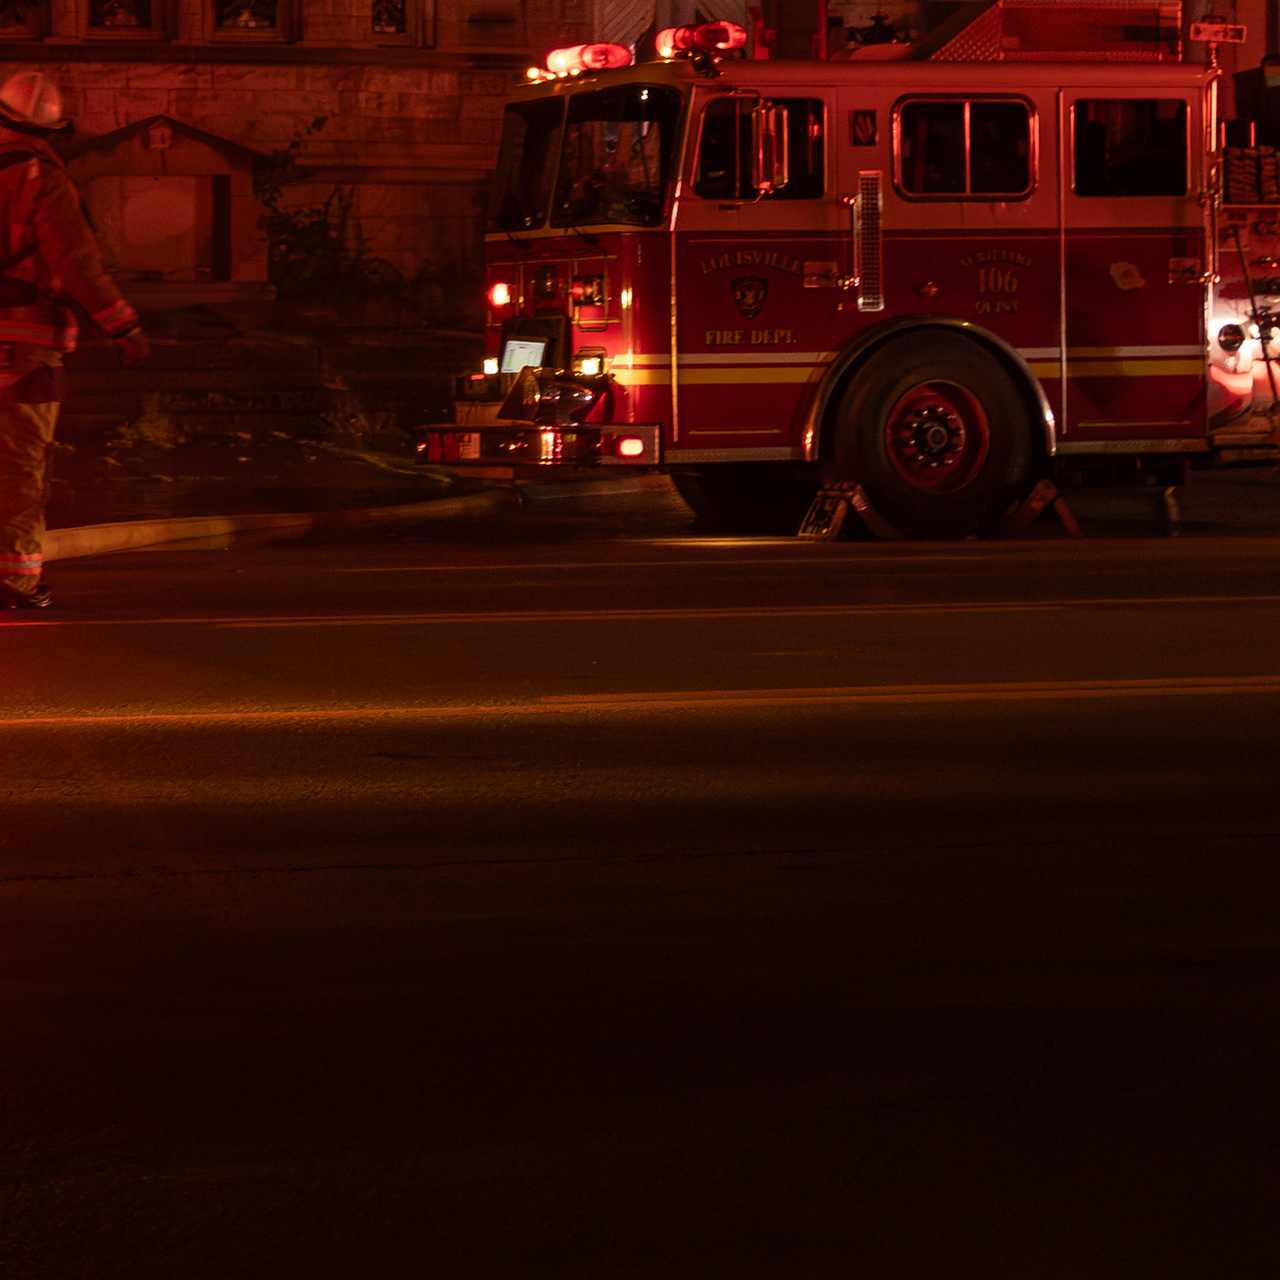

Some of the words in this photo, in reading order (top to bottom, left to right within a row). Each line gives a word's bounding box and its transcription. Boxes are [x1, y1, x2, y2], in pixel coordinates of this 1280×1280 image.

[700, 250, 802, 275] LOUISVILLE
[978, 267, 1018, 294] 106
[705, 330, 745, 345] FIRE
[750, 329, 798, 345] DEPT.
